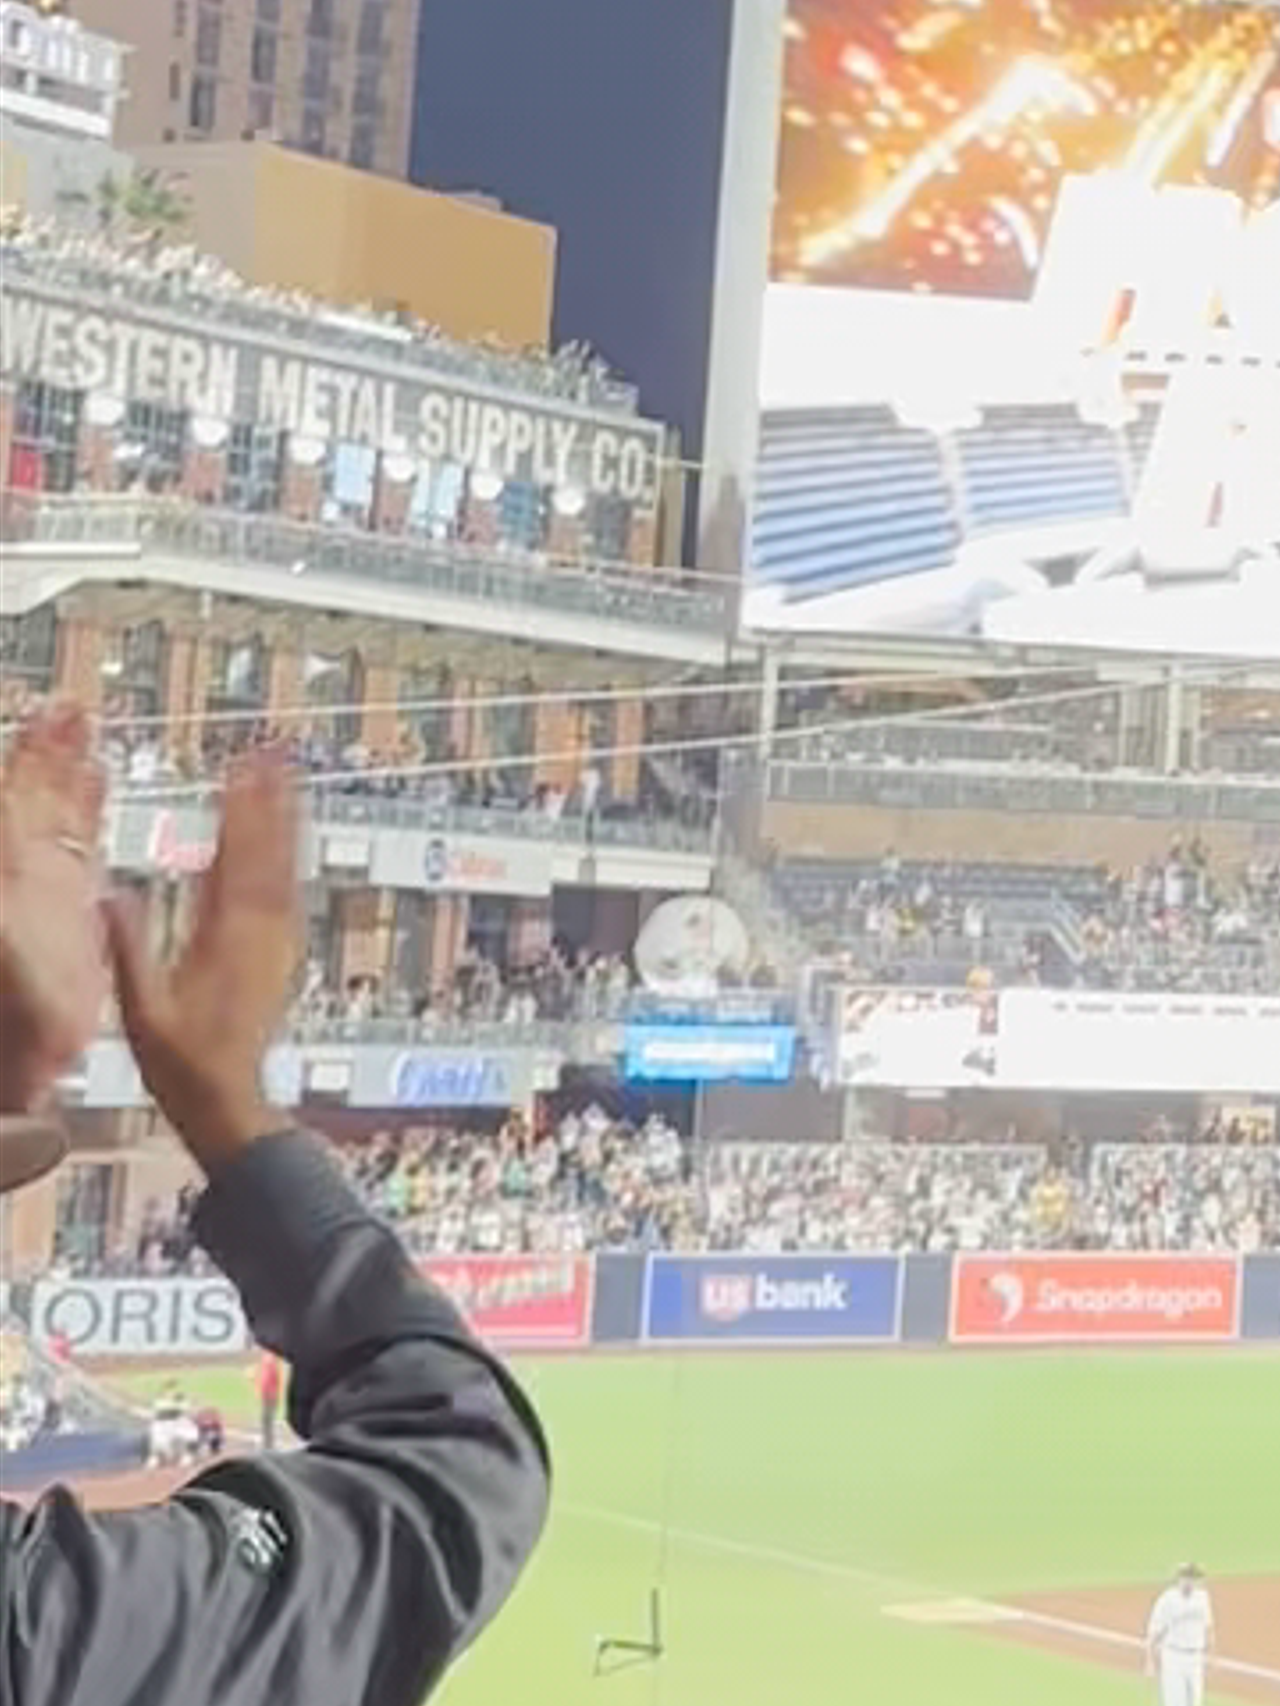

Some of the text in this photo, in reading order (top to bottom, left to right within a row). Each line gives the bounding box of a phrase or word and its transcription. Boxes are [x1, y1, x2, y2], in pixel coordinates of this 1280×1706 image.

[0, 292, 239, 417] WESTERN
[256, 354, 408, 453] METAL
[417, 390, 578, 491] SUPPLY
[42, 1285, 236, 1347] ORIS
[1035, 1278, 1222, 1320] Snapdragon
